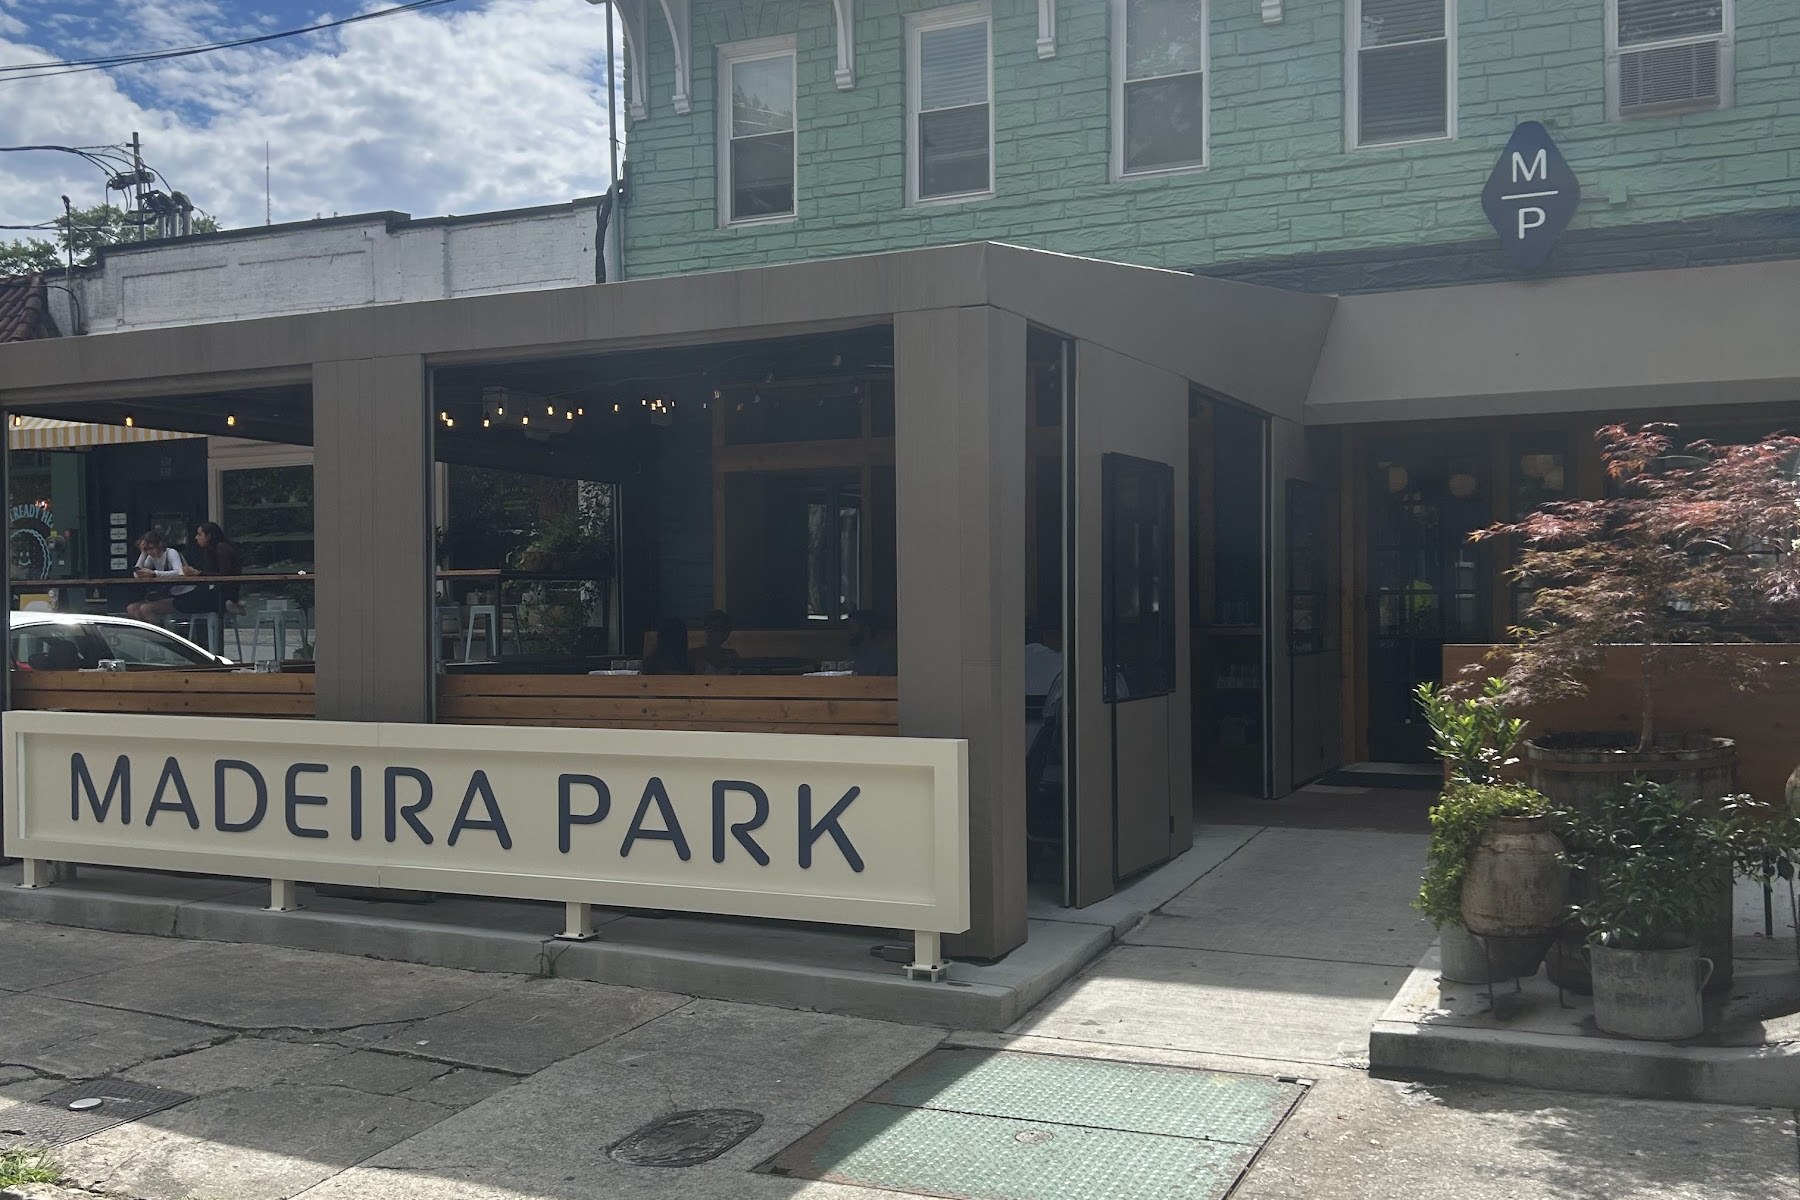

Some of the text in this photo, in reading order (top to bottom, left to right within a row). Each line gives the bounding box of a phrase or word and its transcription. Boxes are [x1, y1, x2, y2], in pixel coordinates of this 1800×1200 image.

[1512, 148, 1547, 183] M
[1518, 206, 1546, 240] P
[70, 751, 865, 873] MADEIRA PARK
